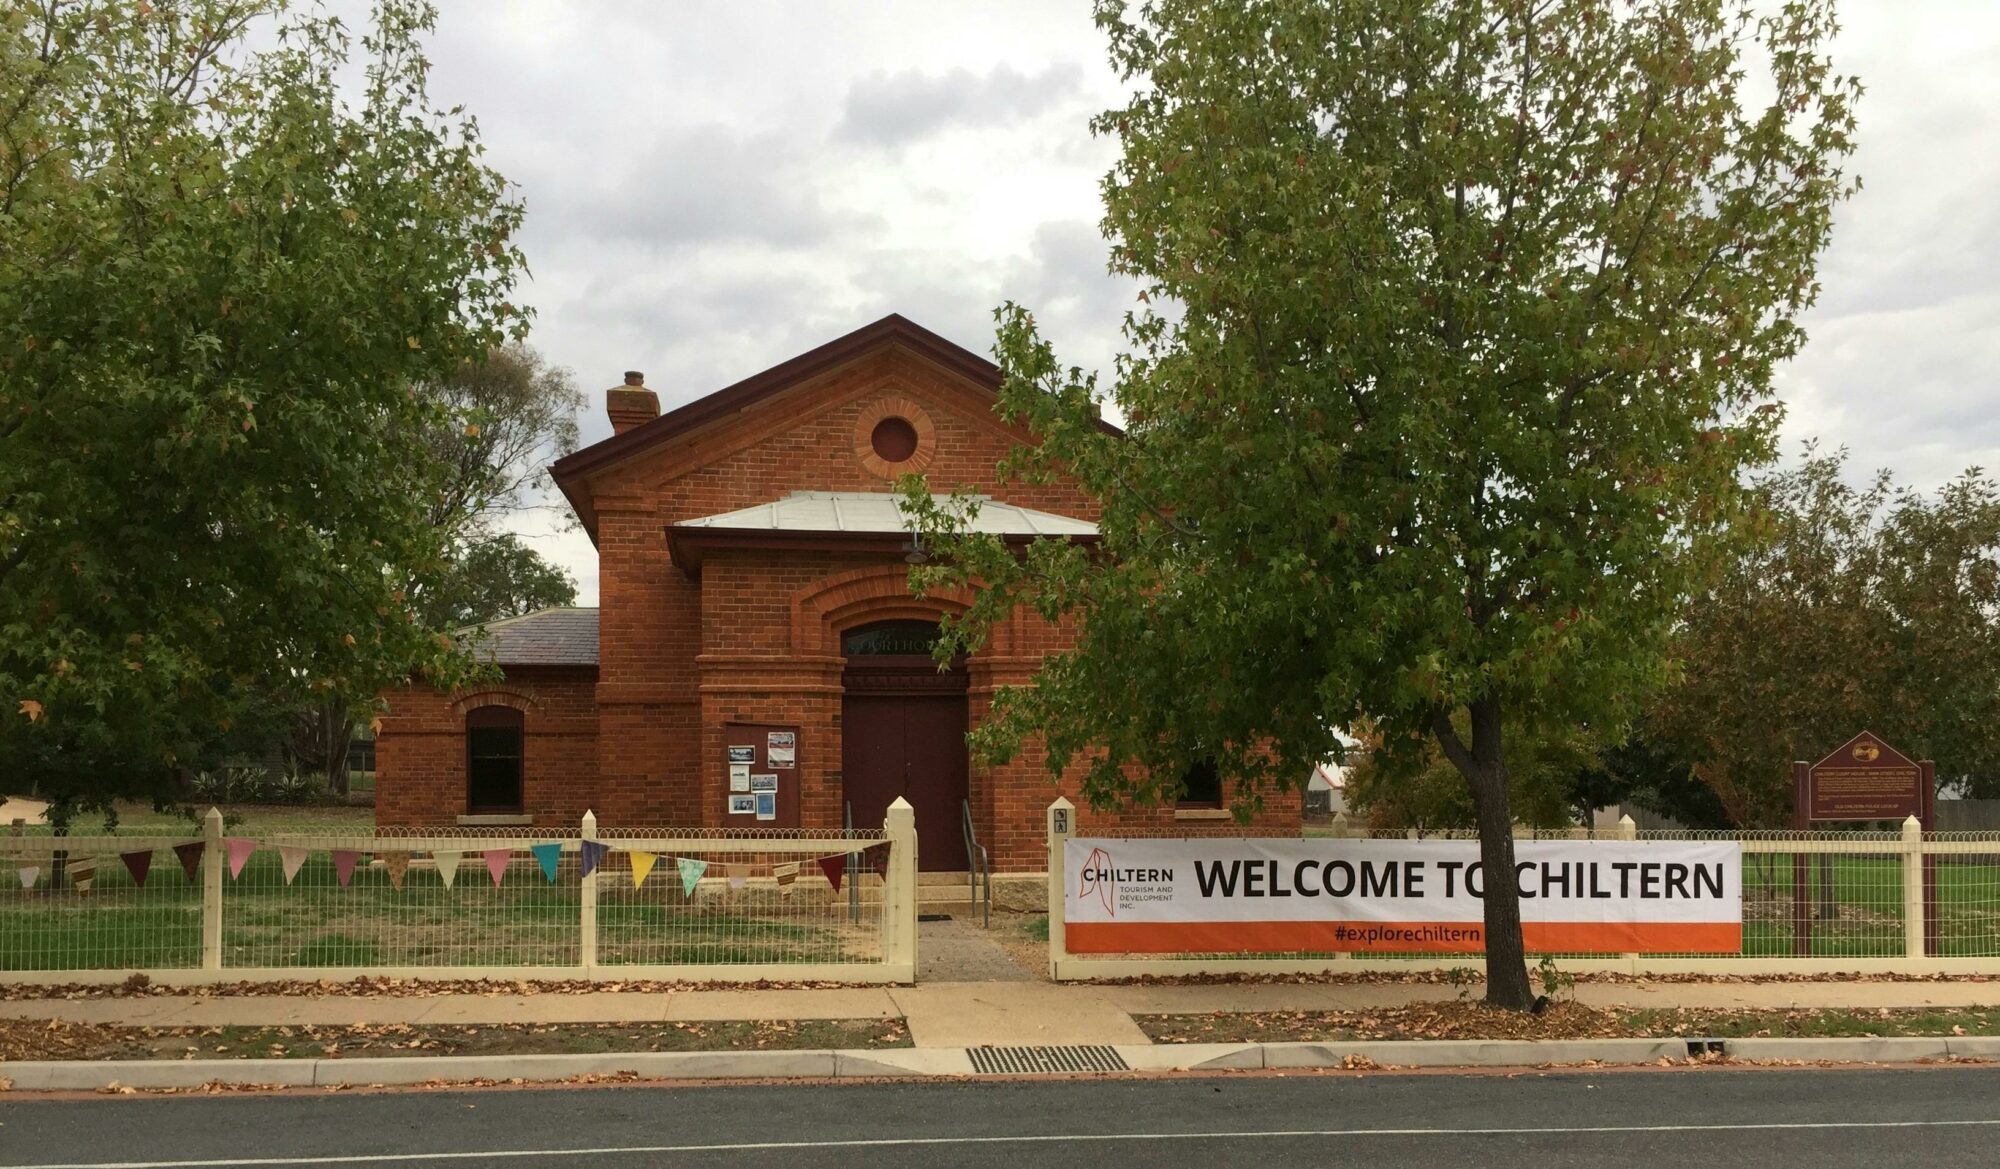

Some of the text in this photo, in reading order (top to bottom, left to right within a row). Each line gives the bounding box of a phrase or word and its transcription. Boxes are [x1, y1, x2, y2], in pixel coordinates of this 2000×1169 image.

[1083, 869, 1173, 882] CHILTERN
[1194, 861, 1425, 898] WELCOME
[1515, 861, 1723, 899] CHILTERN
[1335, 925, 1481, 945] #explorechiltern
